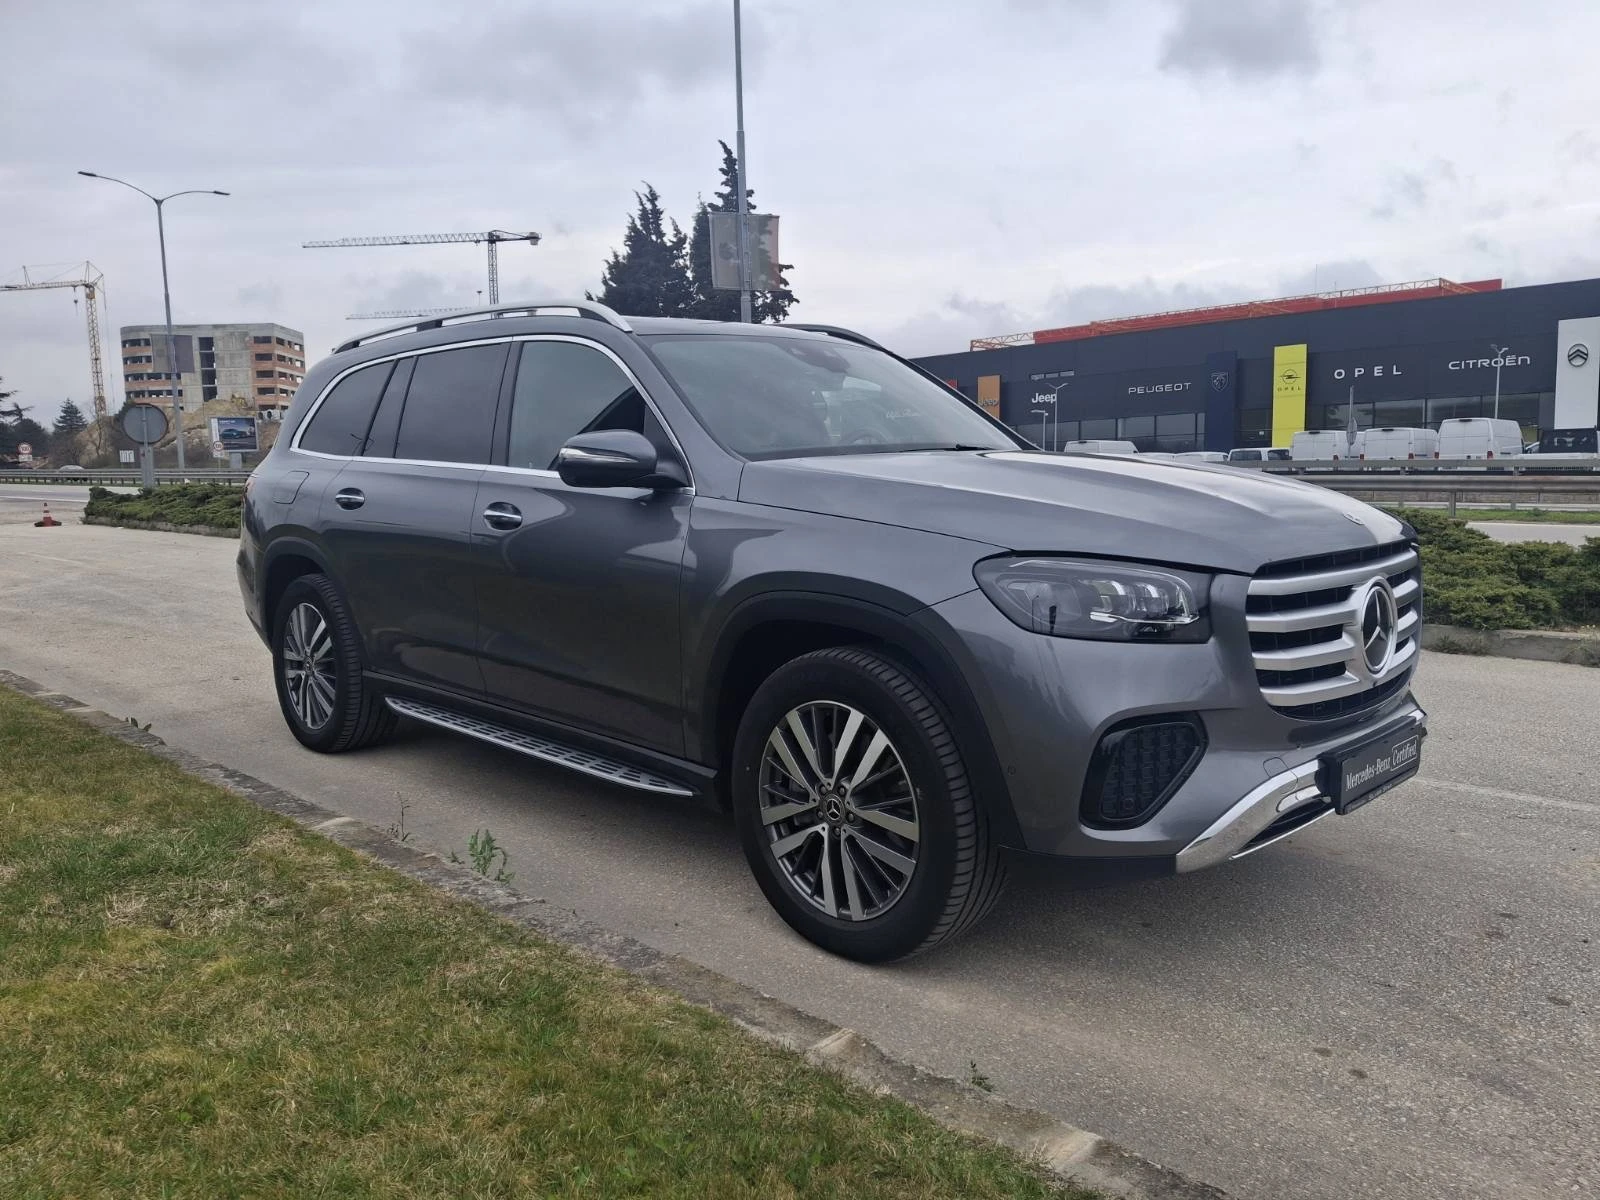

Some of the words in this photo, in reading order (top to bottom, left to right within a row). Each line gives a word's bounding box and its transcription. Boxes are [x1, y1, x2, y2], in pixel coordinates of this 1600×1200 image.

[1333, 364, 1403, 380] OPEL
[1128, 382, 1192, 395] PEUGEOT
[1031, 393, 1057, 404] Jeep
[1346, 757, 1391, 790] Mercedes-Benz
[1392, 740, 1417, 766] Certified
